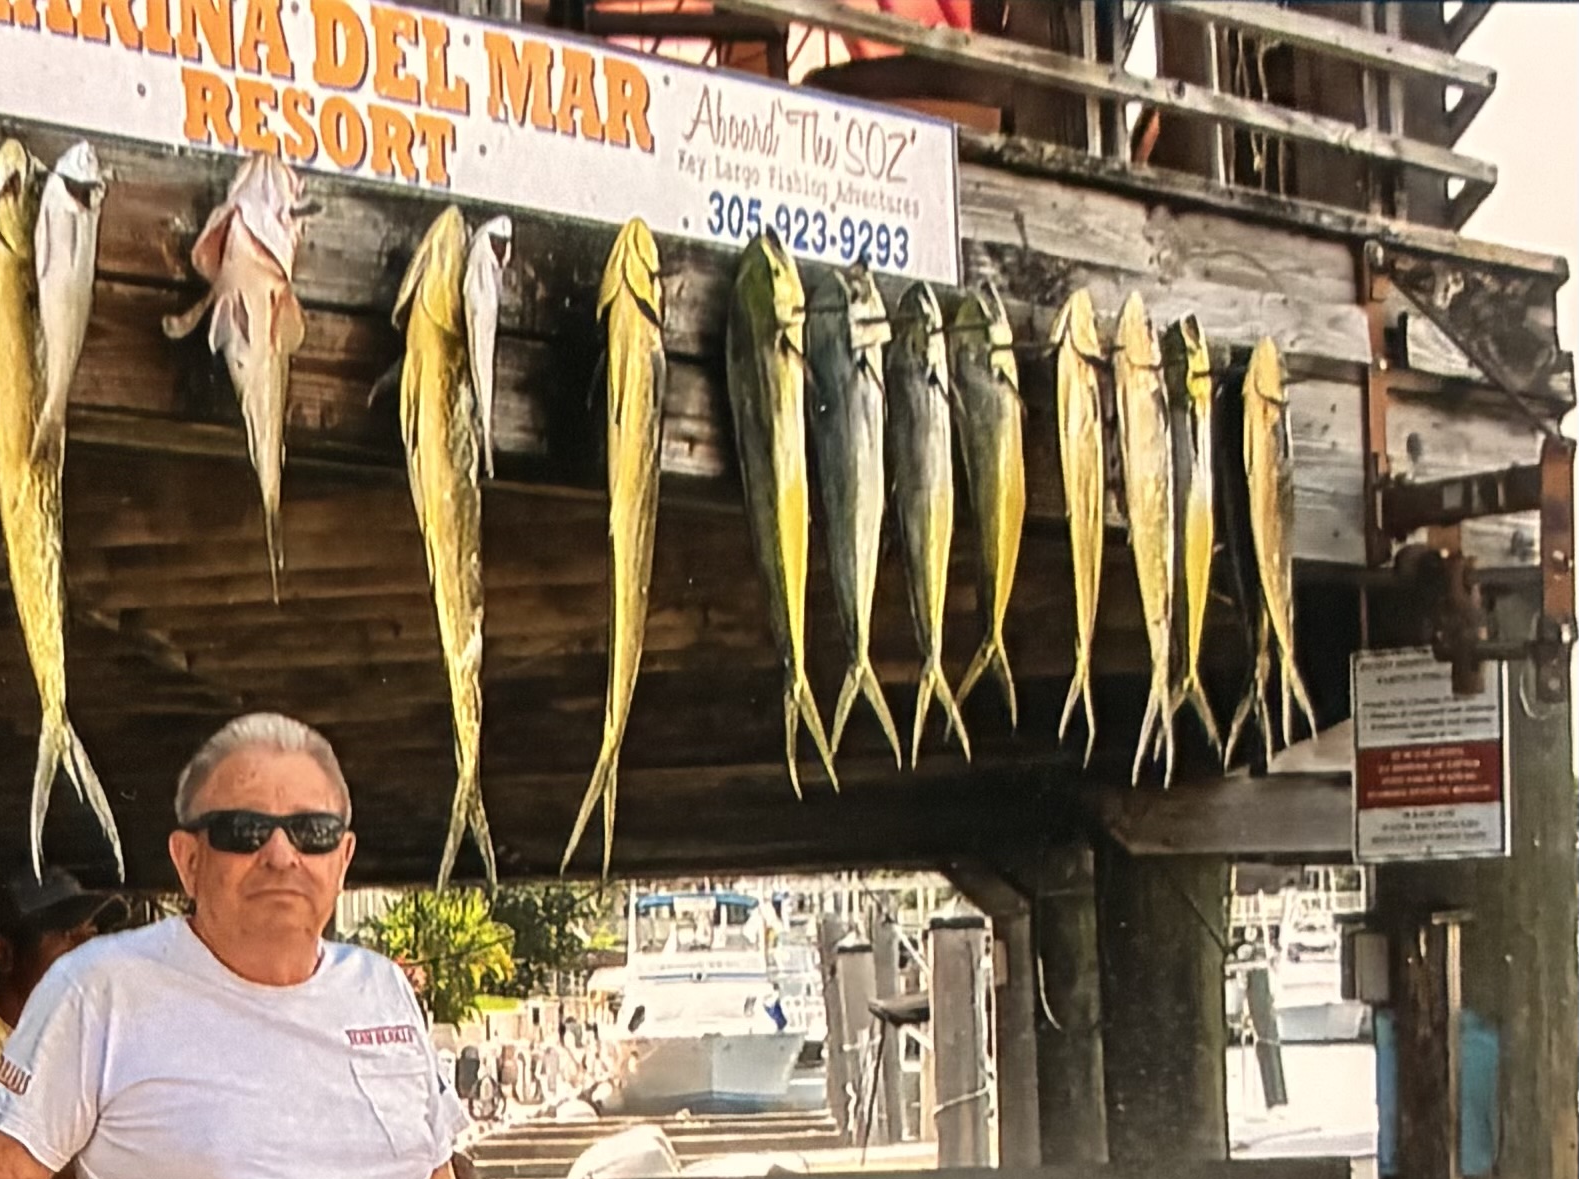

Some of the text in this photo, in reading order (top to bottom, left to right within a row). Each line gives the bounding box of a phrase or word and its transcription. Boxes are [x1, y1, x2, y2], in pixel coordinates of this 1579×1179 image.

[181, 66, 457, 190] RESORT
[311, 0, 470, 116] DEL
[483, 31, 656, 153] MAR
[678, 149, 920, 219] Key Largo Fishing Adventures
